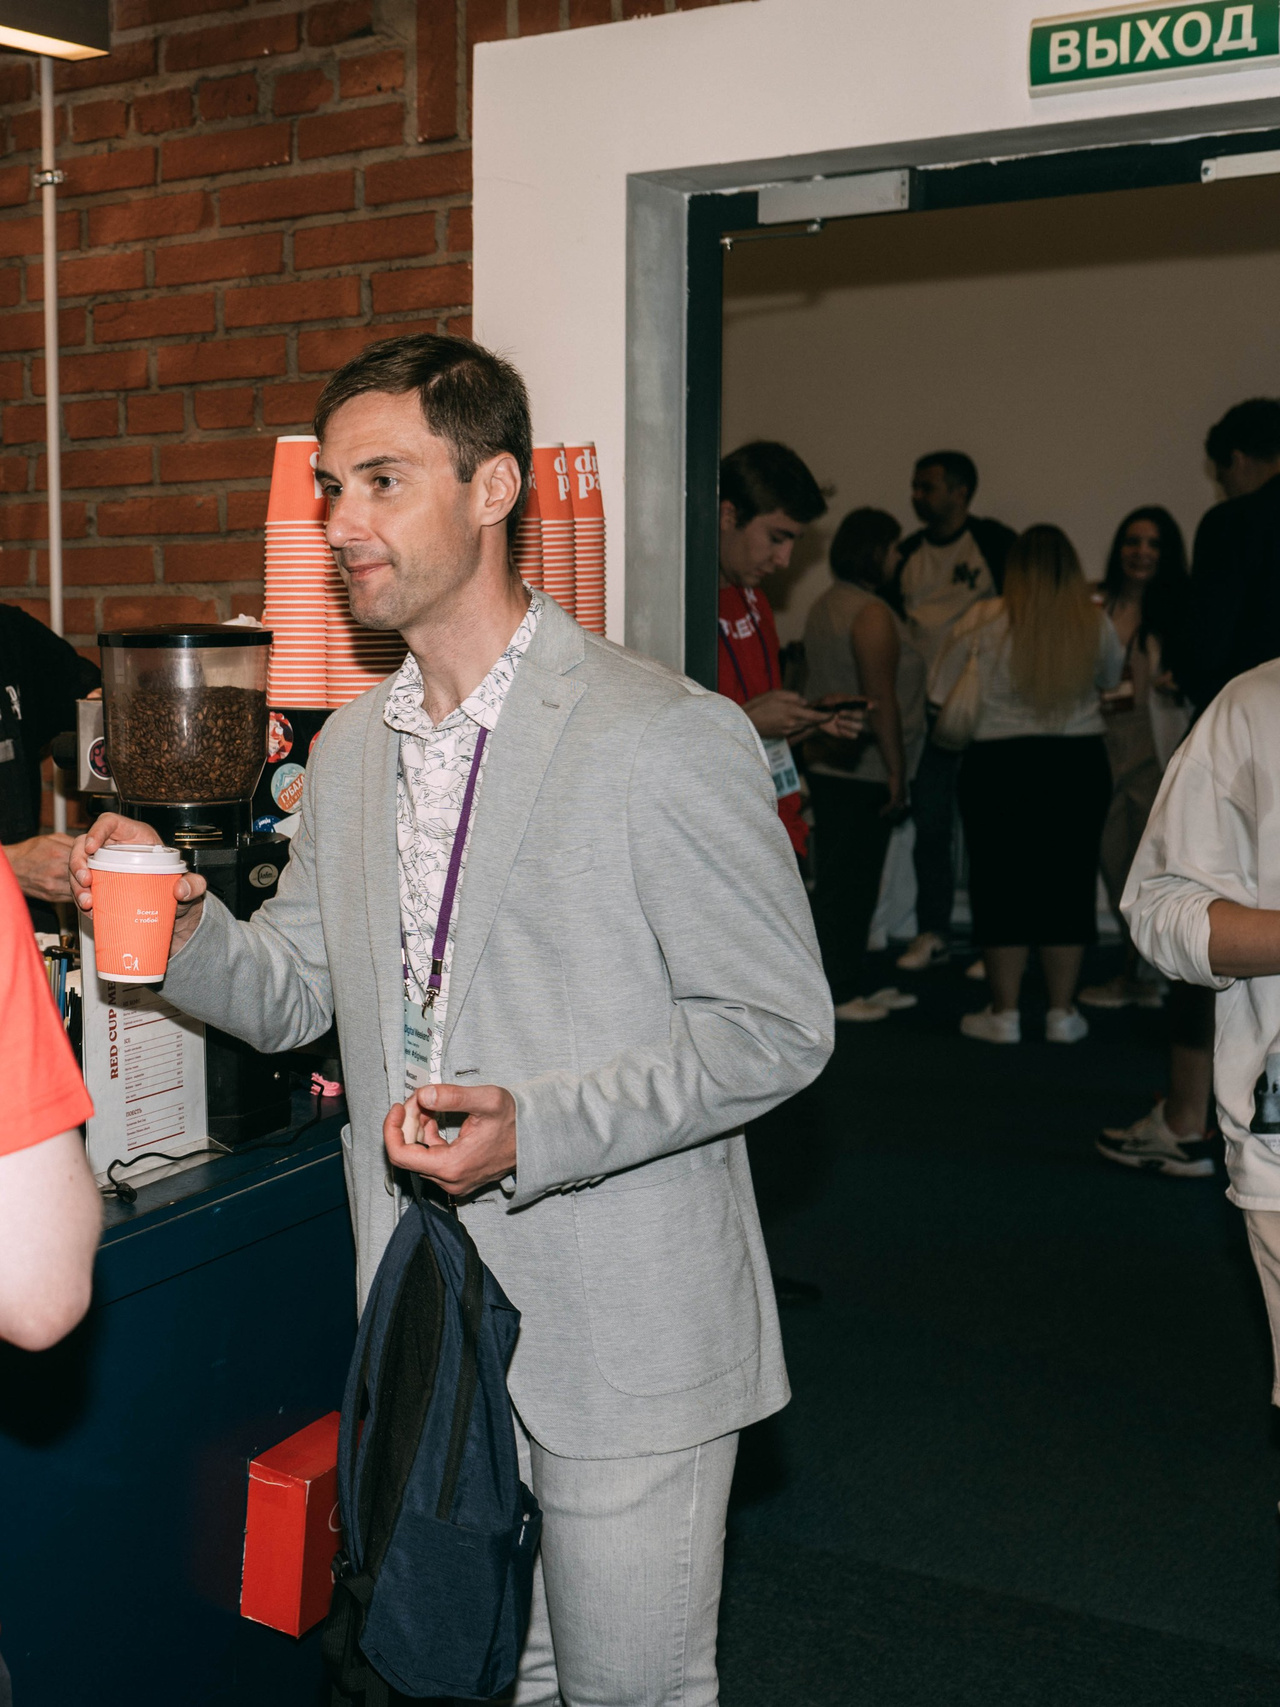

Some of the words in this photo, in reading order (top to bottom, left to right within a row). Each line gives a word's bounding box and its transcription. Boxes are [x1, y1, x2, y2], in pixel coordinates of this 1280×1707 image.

[1049, 5, 1257, 74] ВЫХОД
[108, 981, 116, 1005] ME
[108, 1009, 118, 1042] CUP
[110, 1045, 119, 1079] RED
[126, 1108, 142, 1117] ПОЕСТЬ
